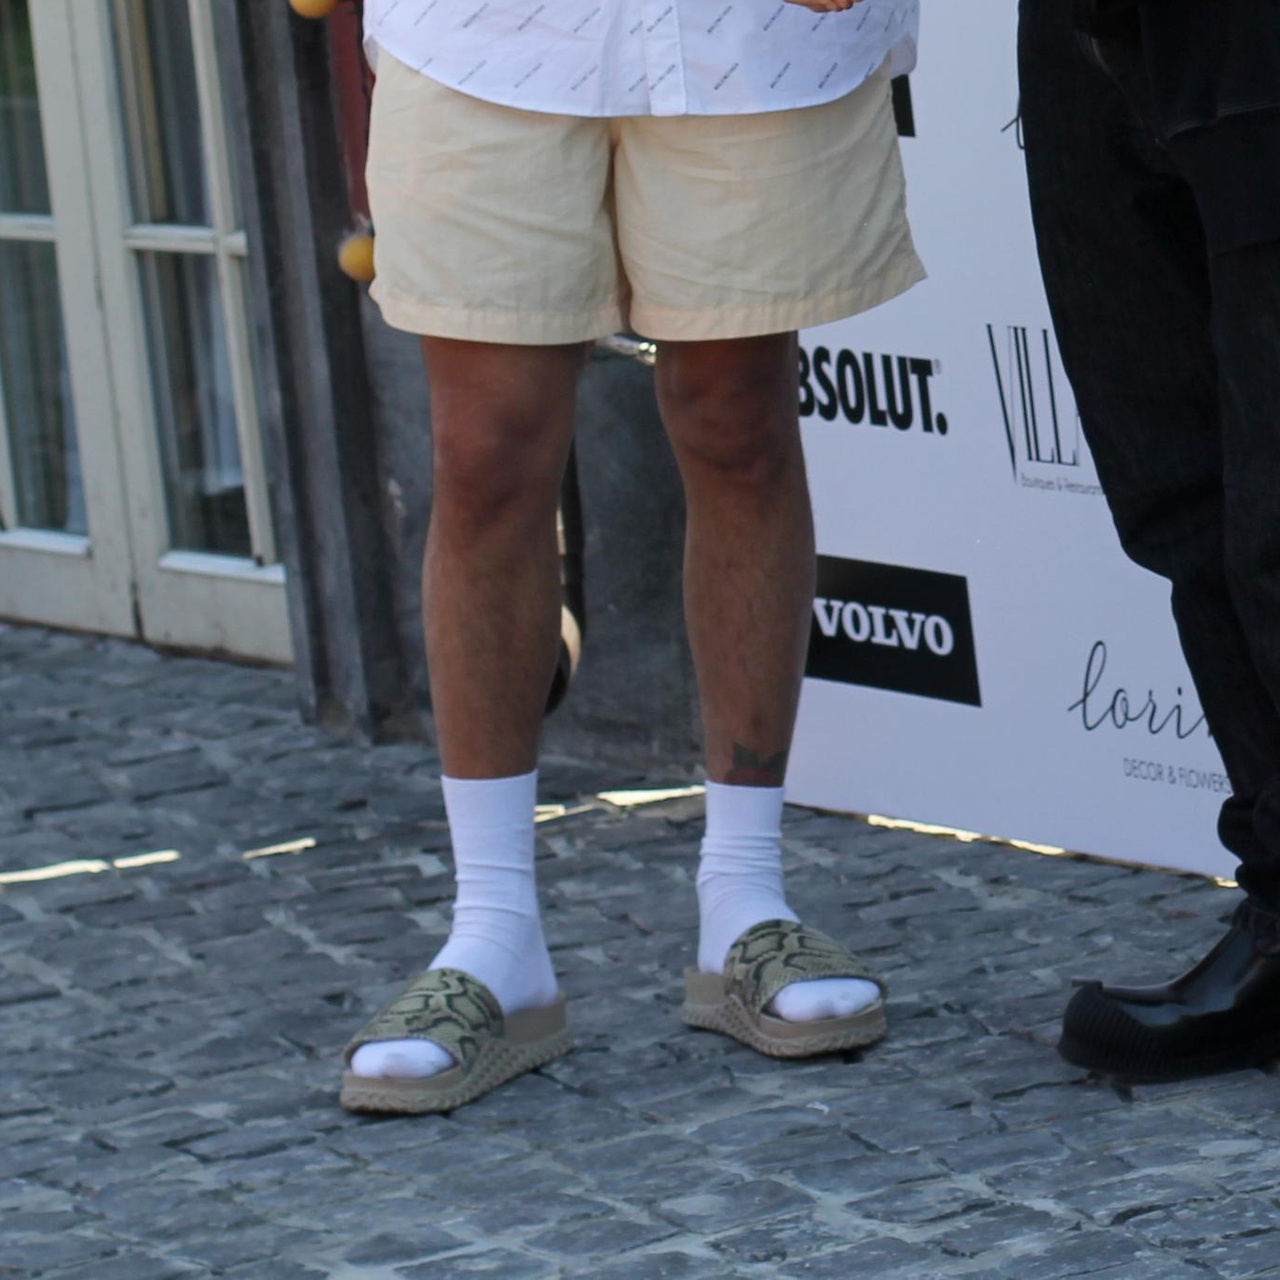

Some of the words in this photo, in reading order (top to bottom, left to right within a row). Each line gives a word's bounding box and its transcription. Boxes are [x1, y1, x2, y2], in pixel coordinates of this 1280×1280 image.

[798, 345, 948, 436] BSOLUT.
[986, 324, 1080, 483] VILL
[812, 597, 953, 656] VOLVO
[1068, 640, 1212, 738] lori
